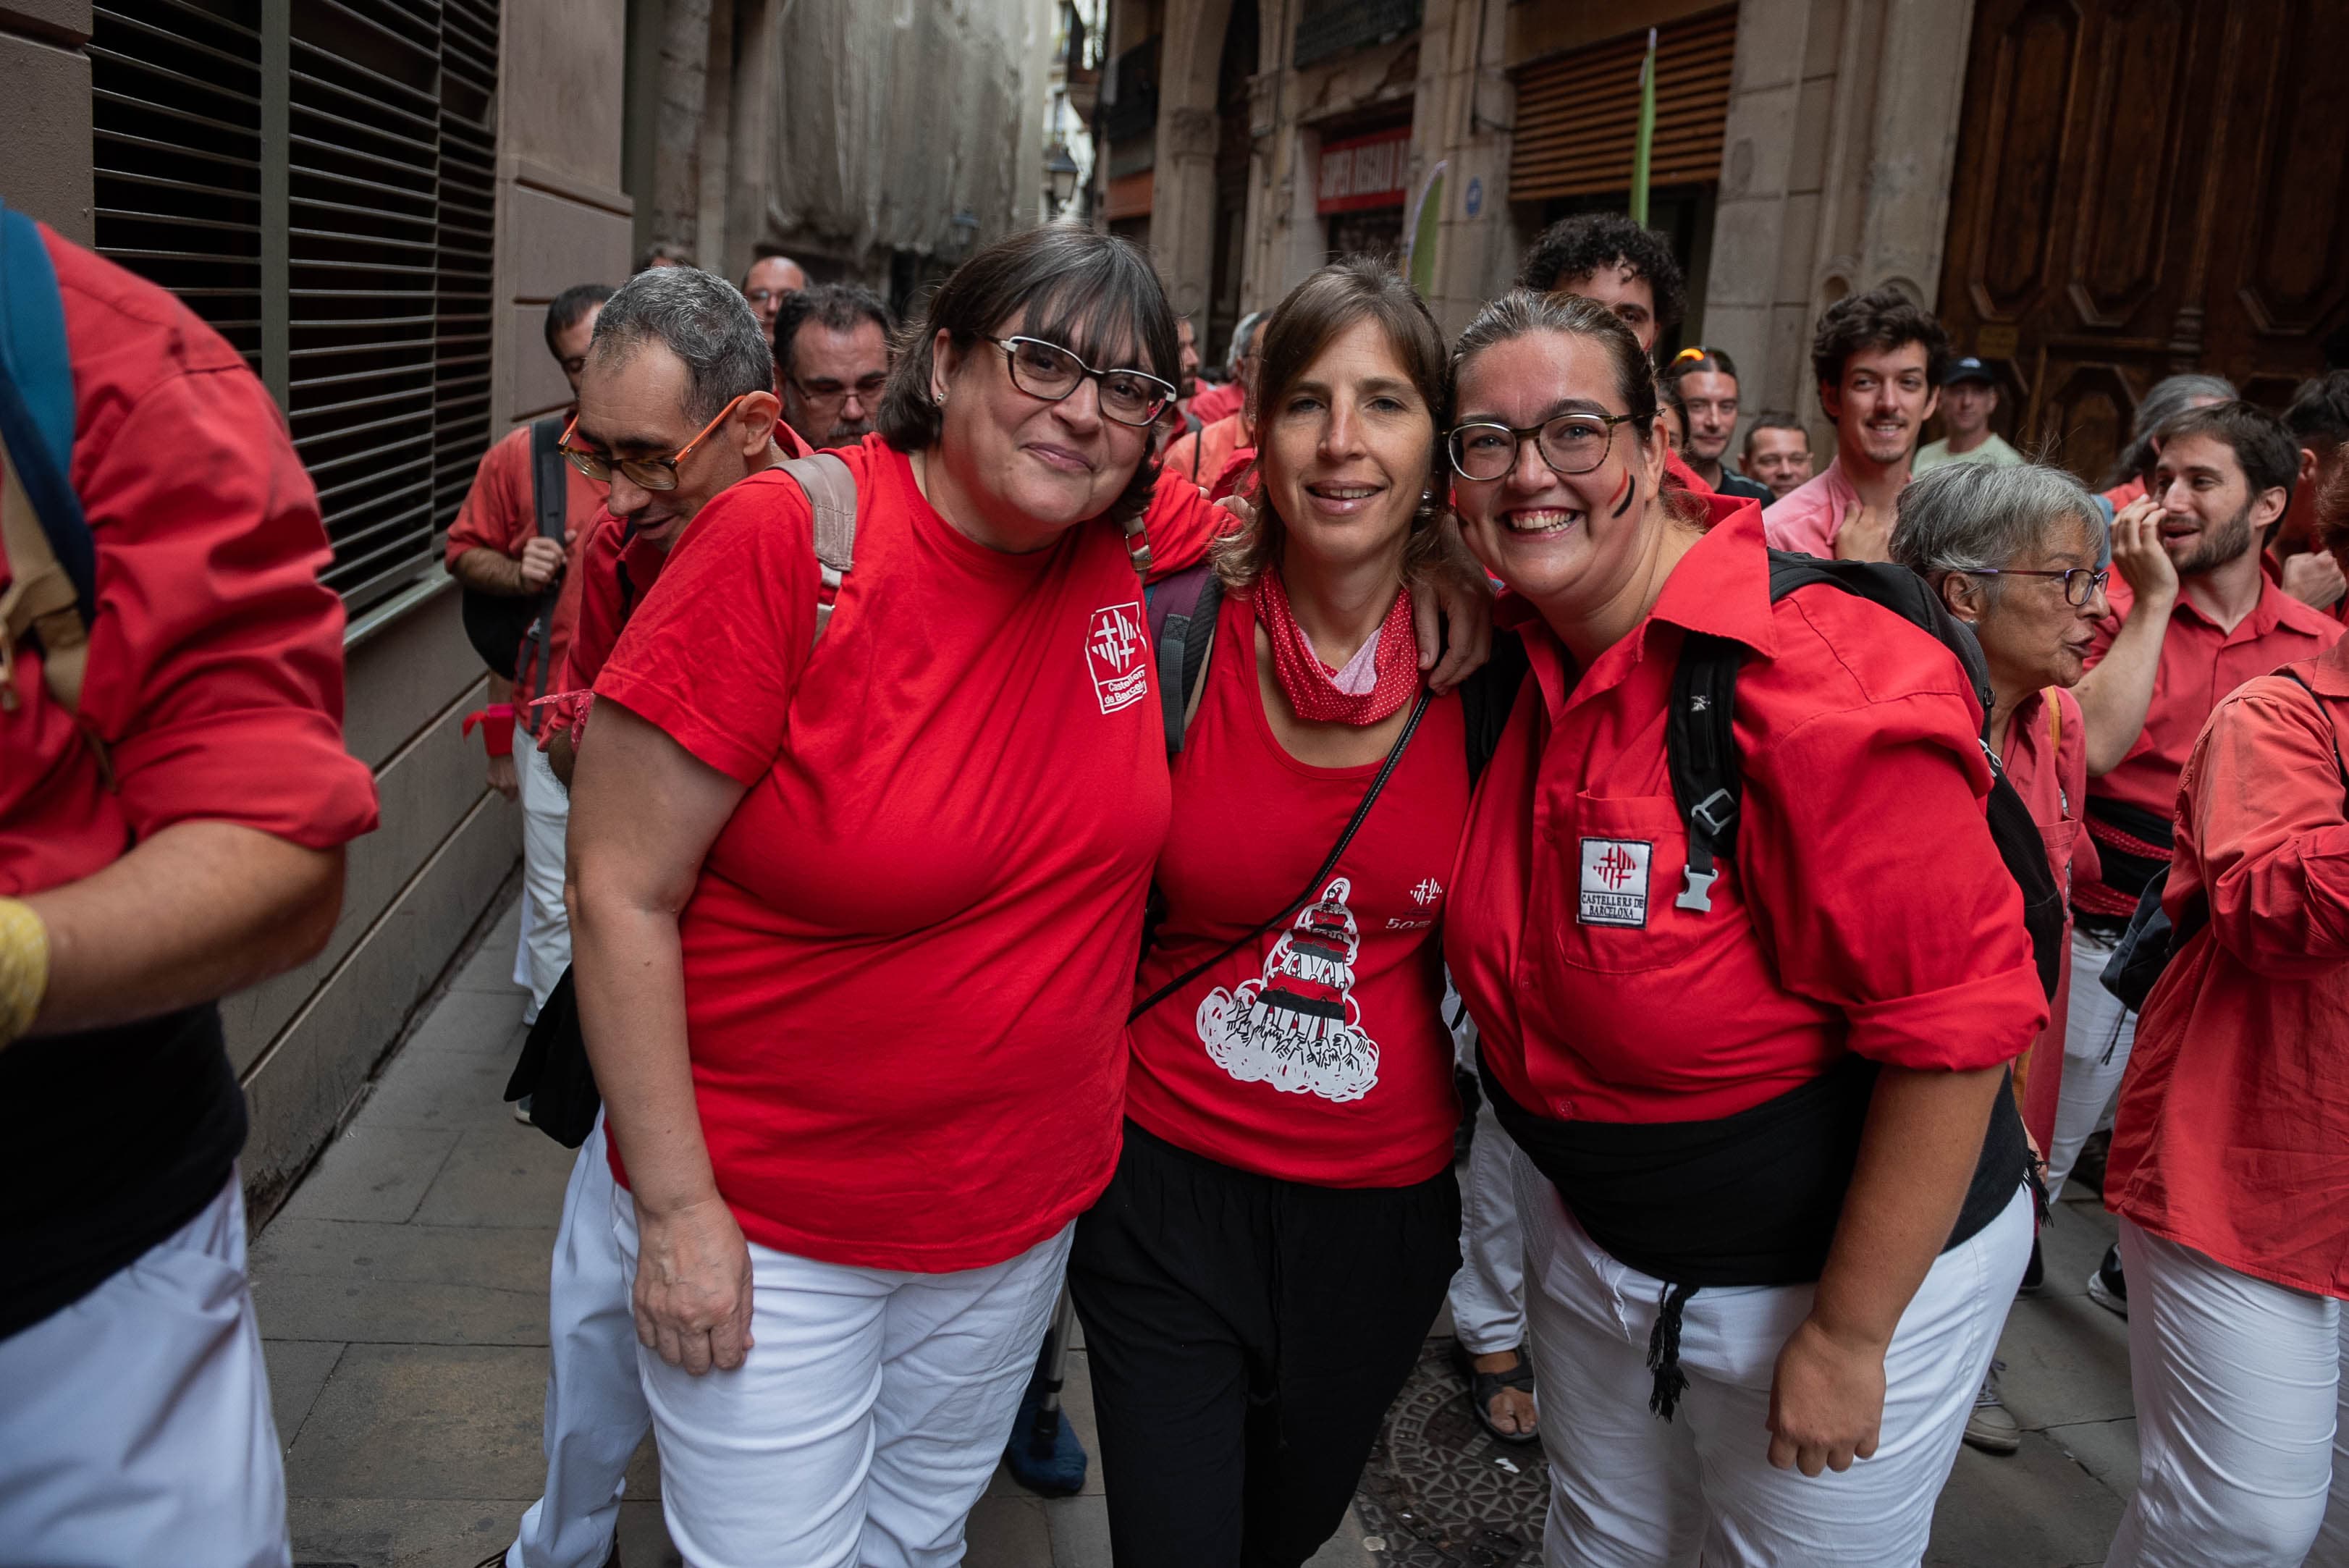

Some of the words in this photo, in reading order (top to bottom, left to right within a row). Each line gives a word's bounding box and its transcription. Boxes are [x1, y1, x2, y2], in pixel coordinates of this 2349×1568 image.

[1105, 694, 1115, 704] de
[1114, 680, 1144, 701] Barcel
[1581, 894, 1632, 907] CASTELLERS
[1634, 898, 1644, 909] DE
[1589, 906, 1633, 919] BARCELONA
